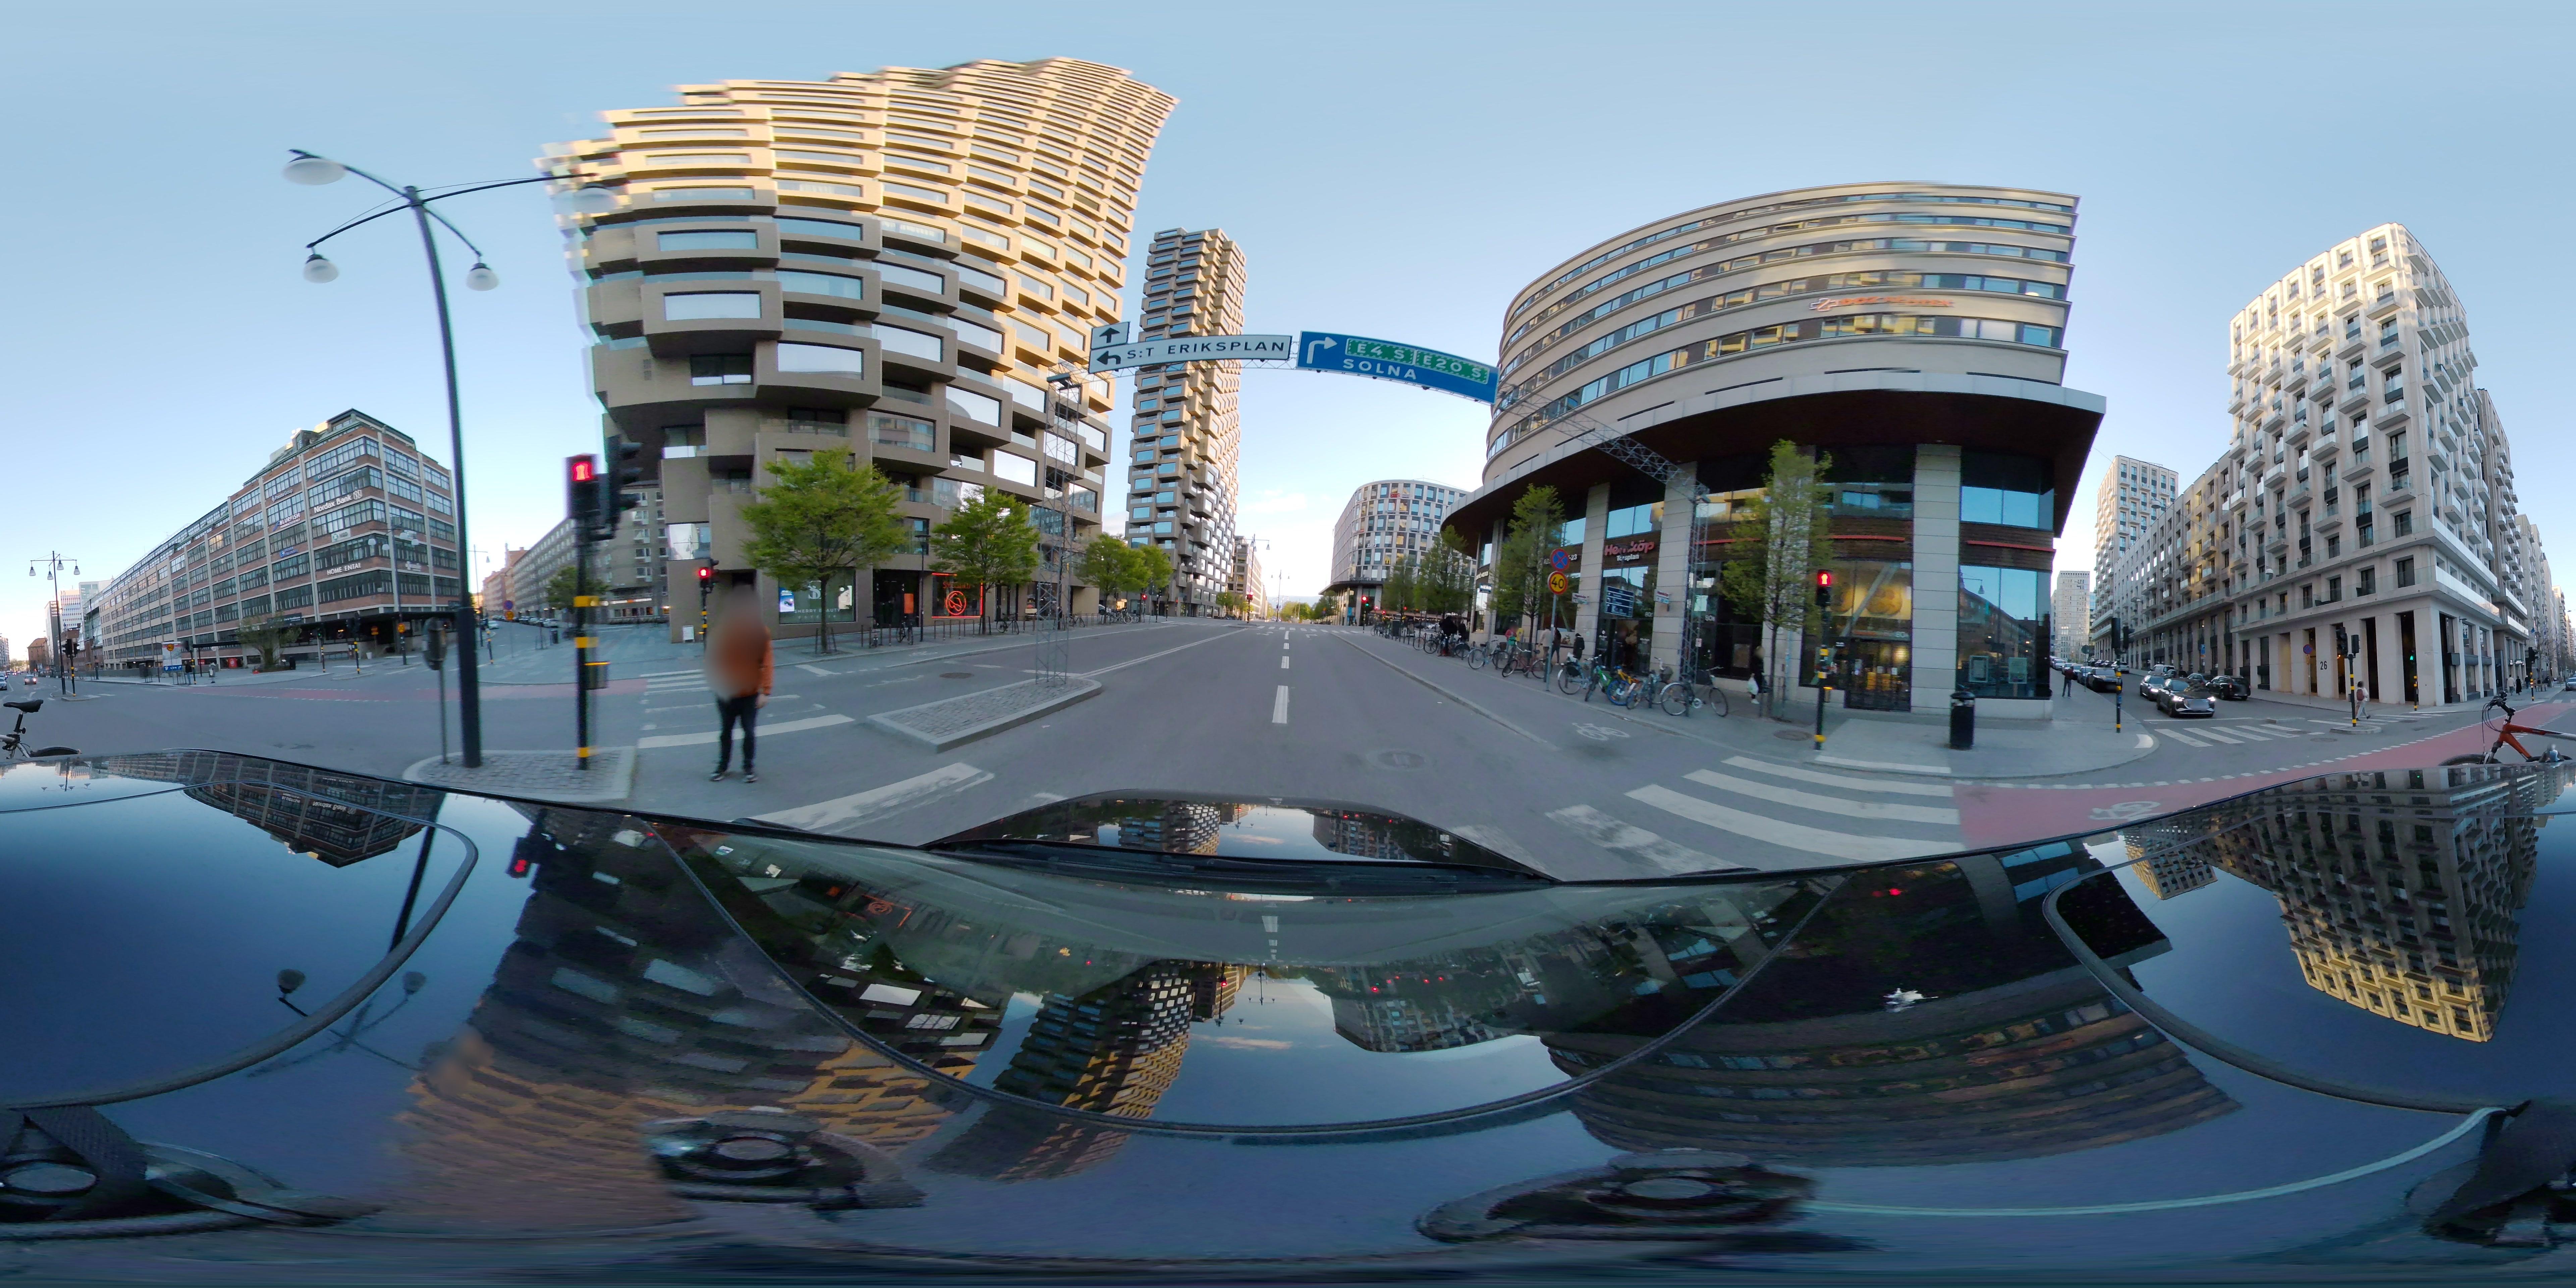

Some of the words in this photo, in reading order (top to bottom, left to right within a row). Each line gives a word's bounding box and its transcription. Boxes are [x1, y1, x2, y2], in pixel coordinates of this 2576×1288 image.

[1127, 347, 1154, 359] S:T
[1168, 341, 1284, 354] ERIKSPLAN
[1357, 343, 1383, 356] E4
[1394, 350, 1404, 360] S
[1343, 358, 1417, 380] SOLNA
[1423, 355, 1462, 372] E20
[1471, 368, 1482, 378] S
[314, 502, 335, 513] Nordax
[336, 494, 352, 505] Bank
[327, 567, 342, 575] HOME
[1552, 577, 1564, 589] 40
[2320, 661, 2327, 670] 26
